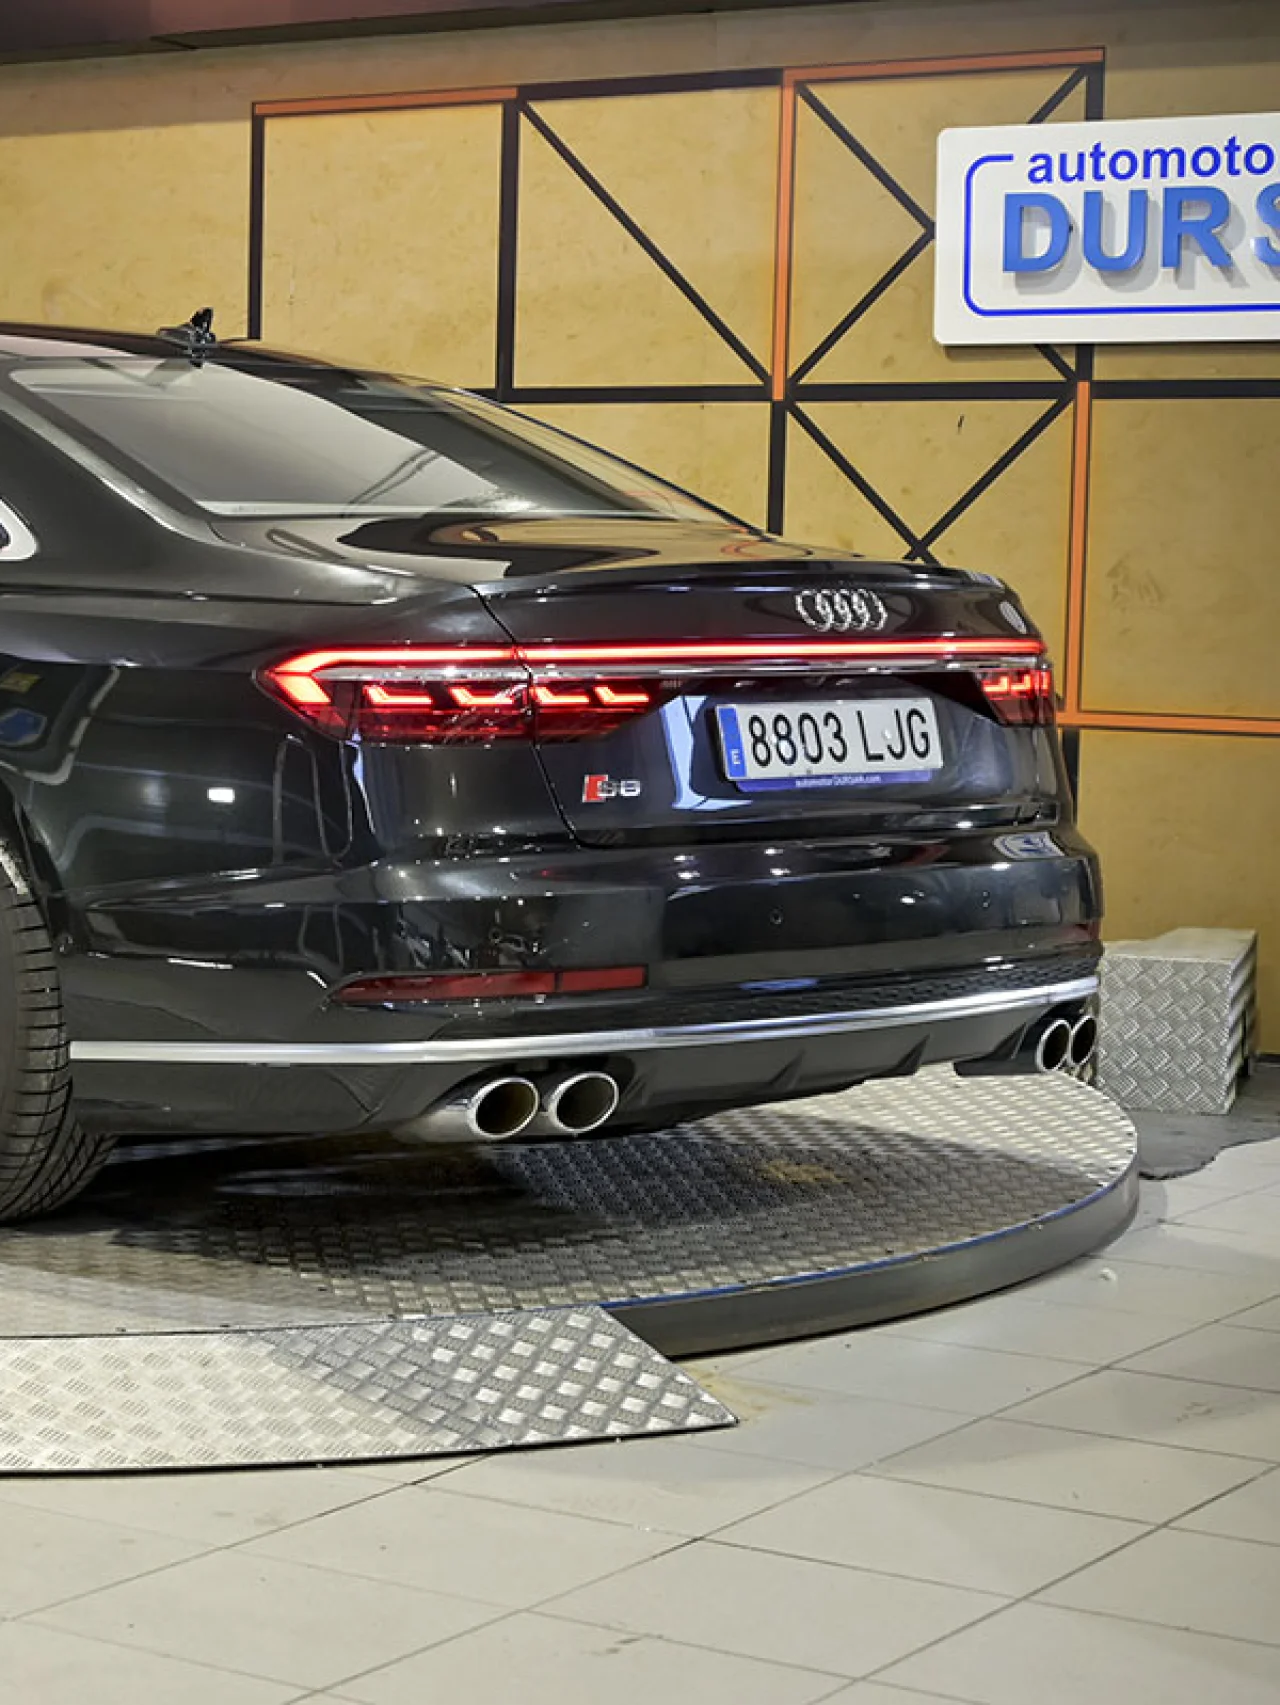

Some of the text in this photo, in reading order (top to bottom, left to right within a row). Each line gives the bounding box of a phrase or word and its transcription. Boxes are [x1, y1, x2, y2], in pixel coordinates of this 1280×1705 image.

[1027, 136, 1279, 184] automoto
[748, 708, 930, 767] 8803 LJG
